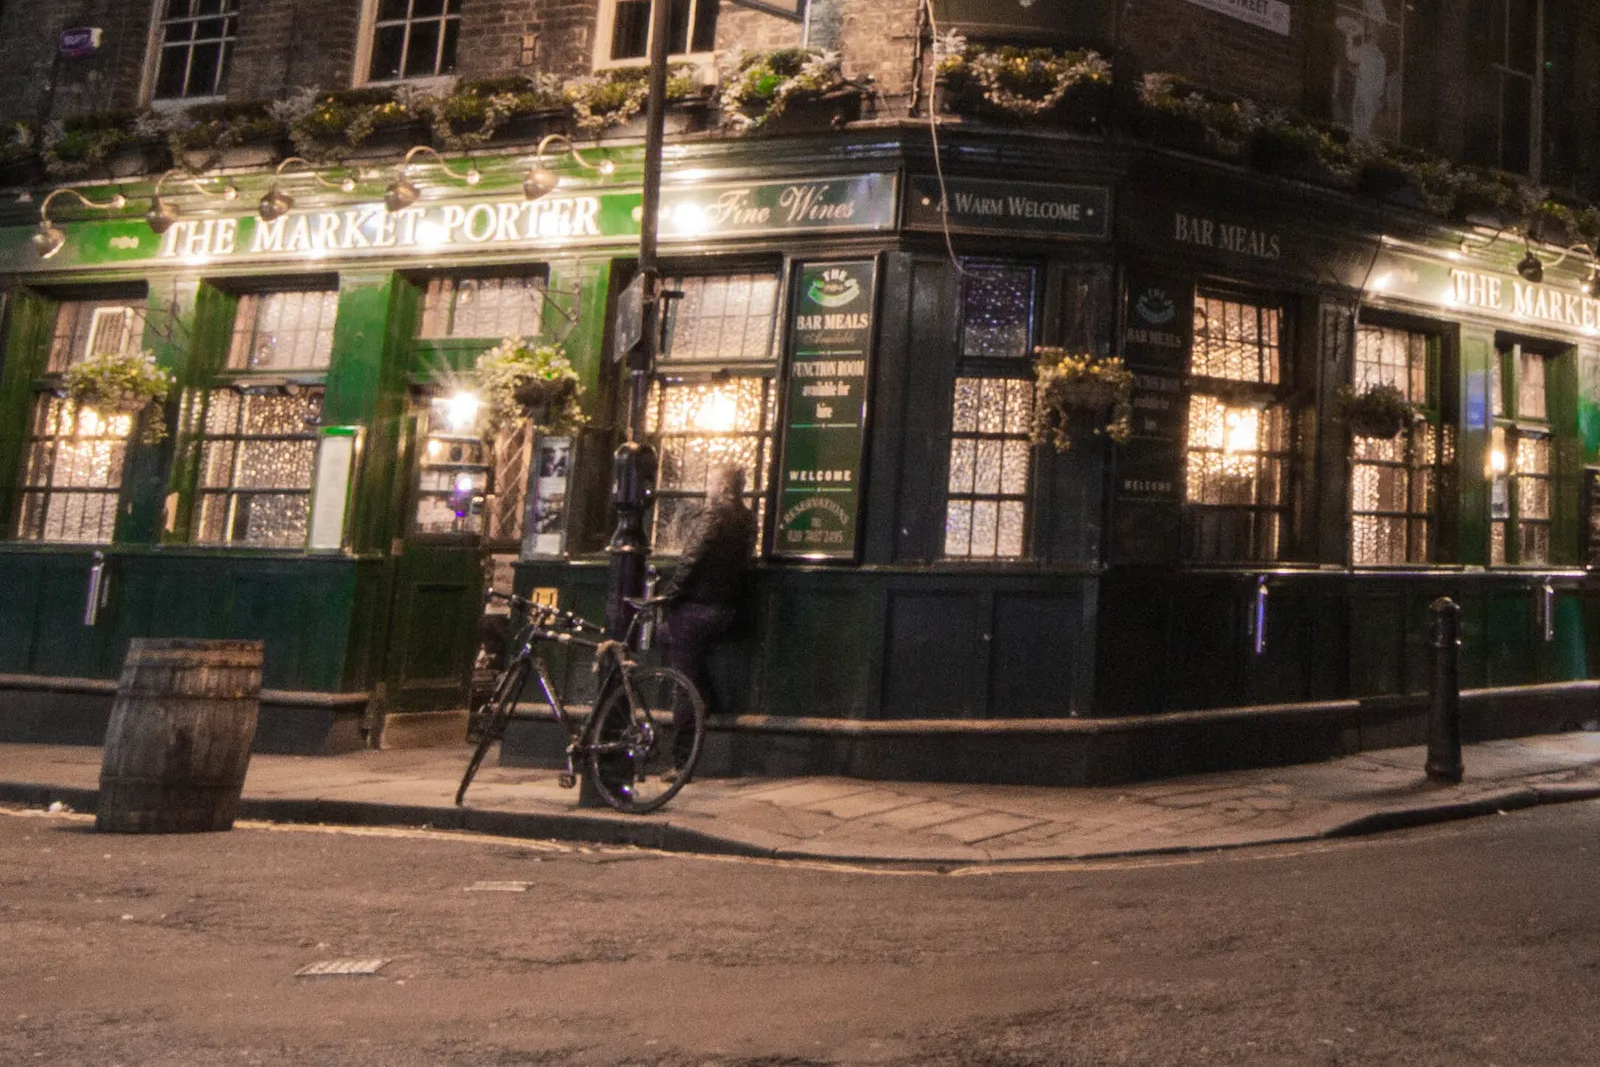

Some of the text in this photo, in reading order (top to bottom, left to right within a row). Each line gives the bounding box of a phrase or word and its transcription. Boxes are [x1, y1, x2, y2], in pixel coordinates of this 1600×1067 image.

[704, 184, 856, 226] Fine Wines
[953, 192, 1004, 216] WARM
[1006, 195, 1082, 222] WELCOME
[159, 195, 602, 258] THE MARKET PORTER
[1173, 212, 1281, 261] BAR MEALS
[822, 268, 848, 282] THE
[1450, 268, 1503, 309] THE
[796, 312, 869, 330] BAR MEALS
[788, 469, 853, 482] WELCOME
